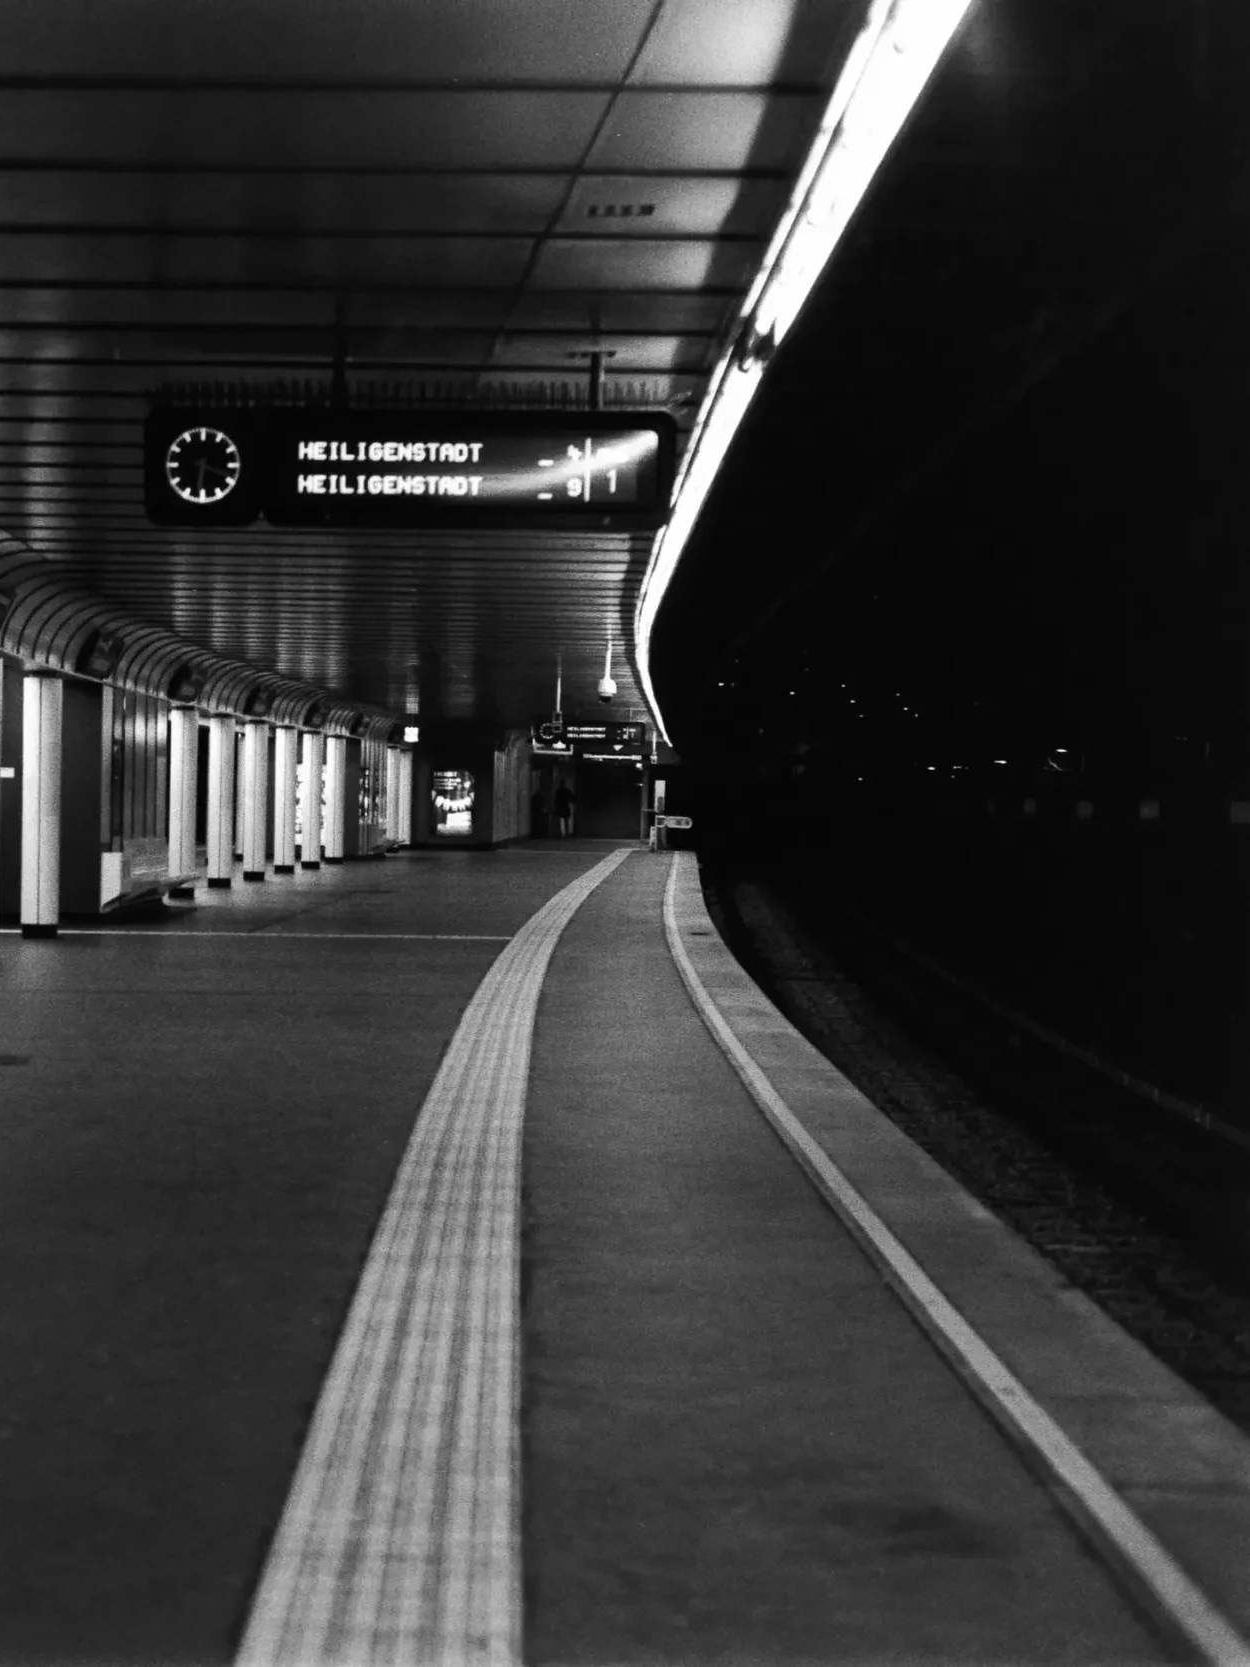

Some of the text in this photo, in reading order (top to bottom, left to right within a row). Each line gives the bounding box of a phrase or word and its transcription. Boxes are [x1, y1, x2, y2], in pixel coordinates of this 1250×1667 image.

[298, 441, 483, 463] HEILIGENSTADT
[297, 474, 582, 497] HEILIGENSTADT 9
